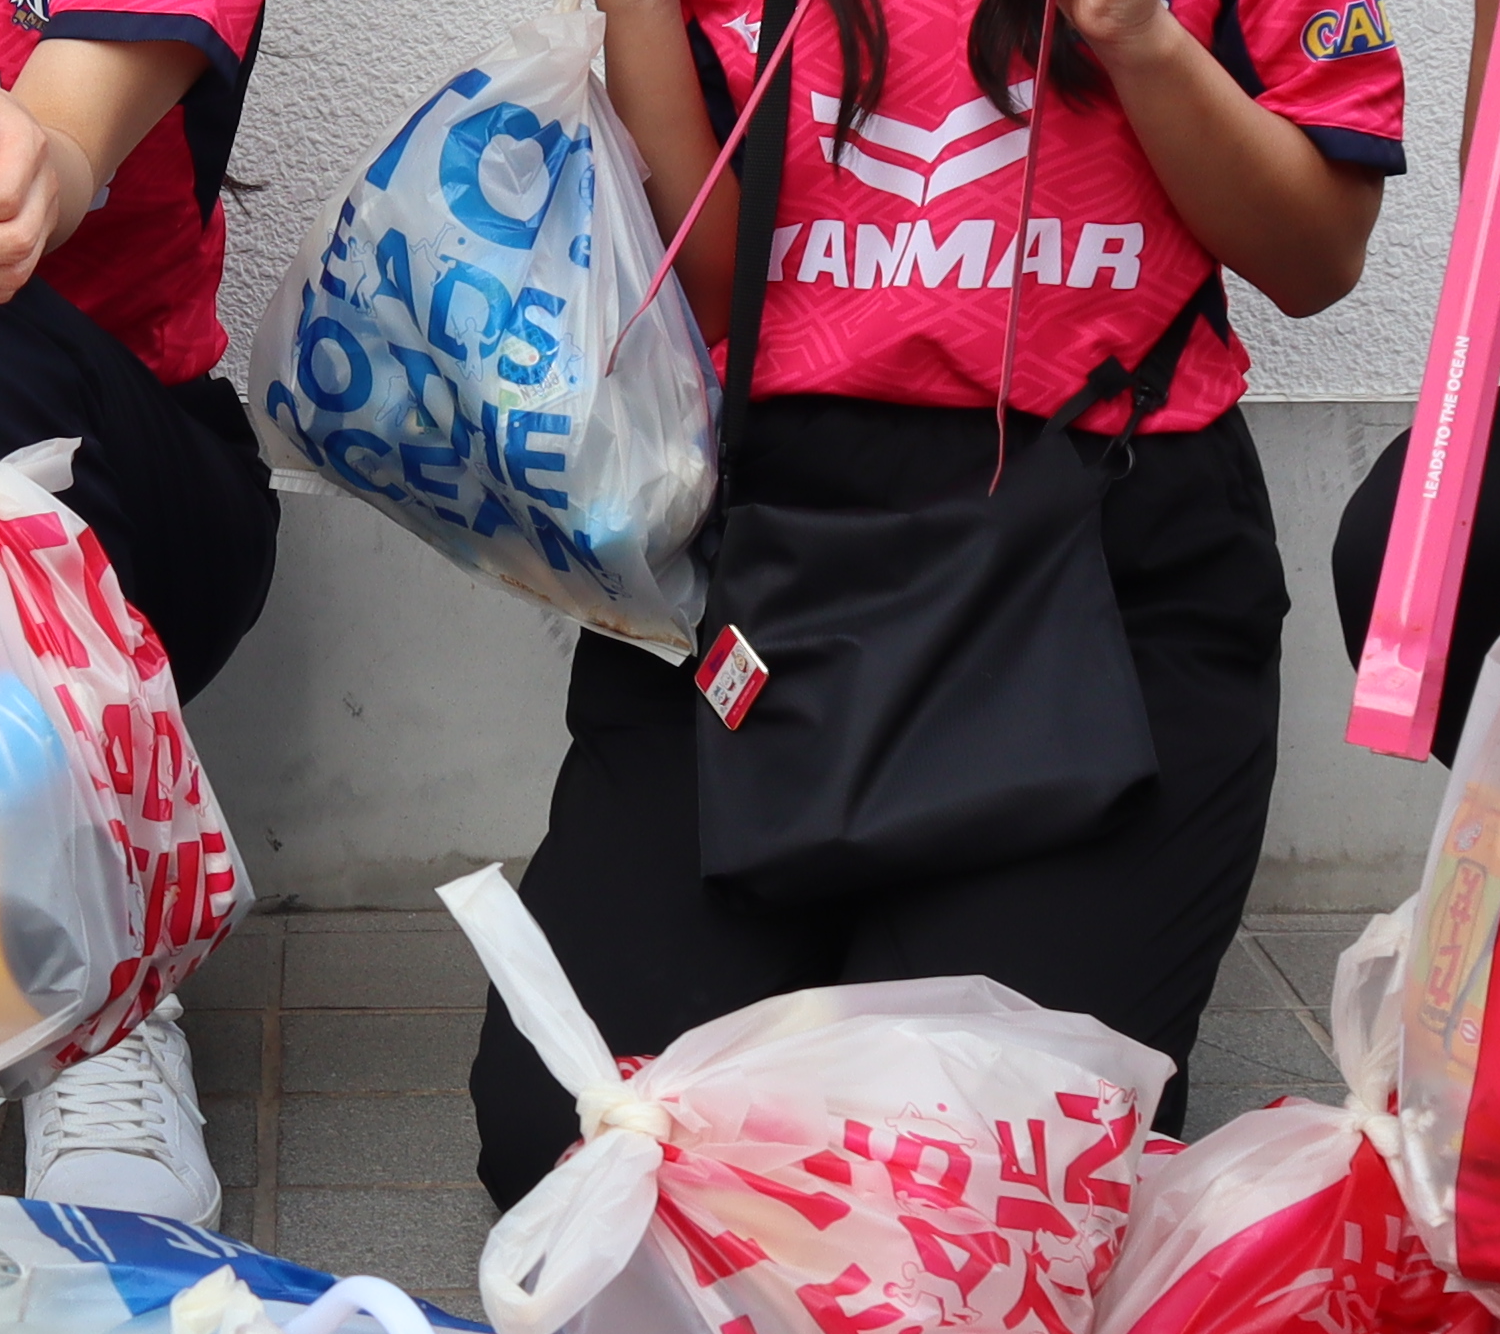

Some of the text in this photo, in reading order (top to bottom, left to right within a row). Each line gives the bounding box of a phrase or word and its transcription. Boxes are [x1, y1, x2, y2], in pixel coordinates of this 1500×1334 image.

[1423, 335, 1470, 499] LEADS TO THE OCEAN
